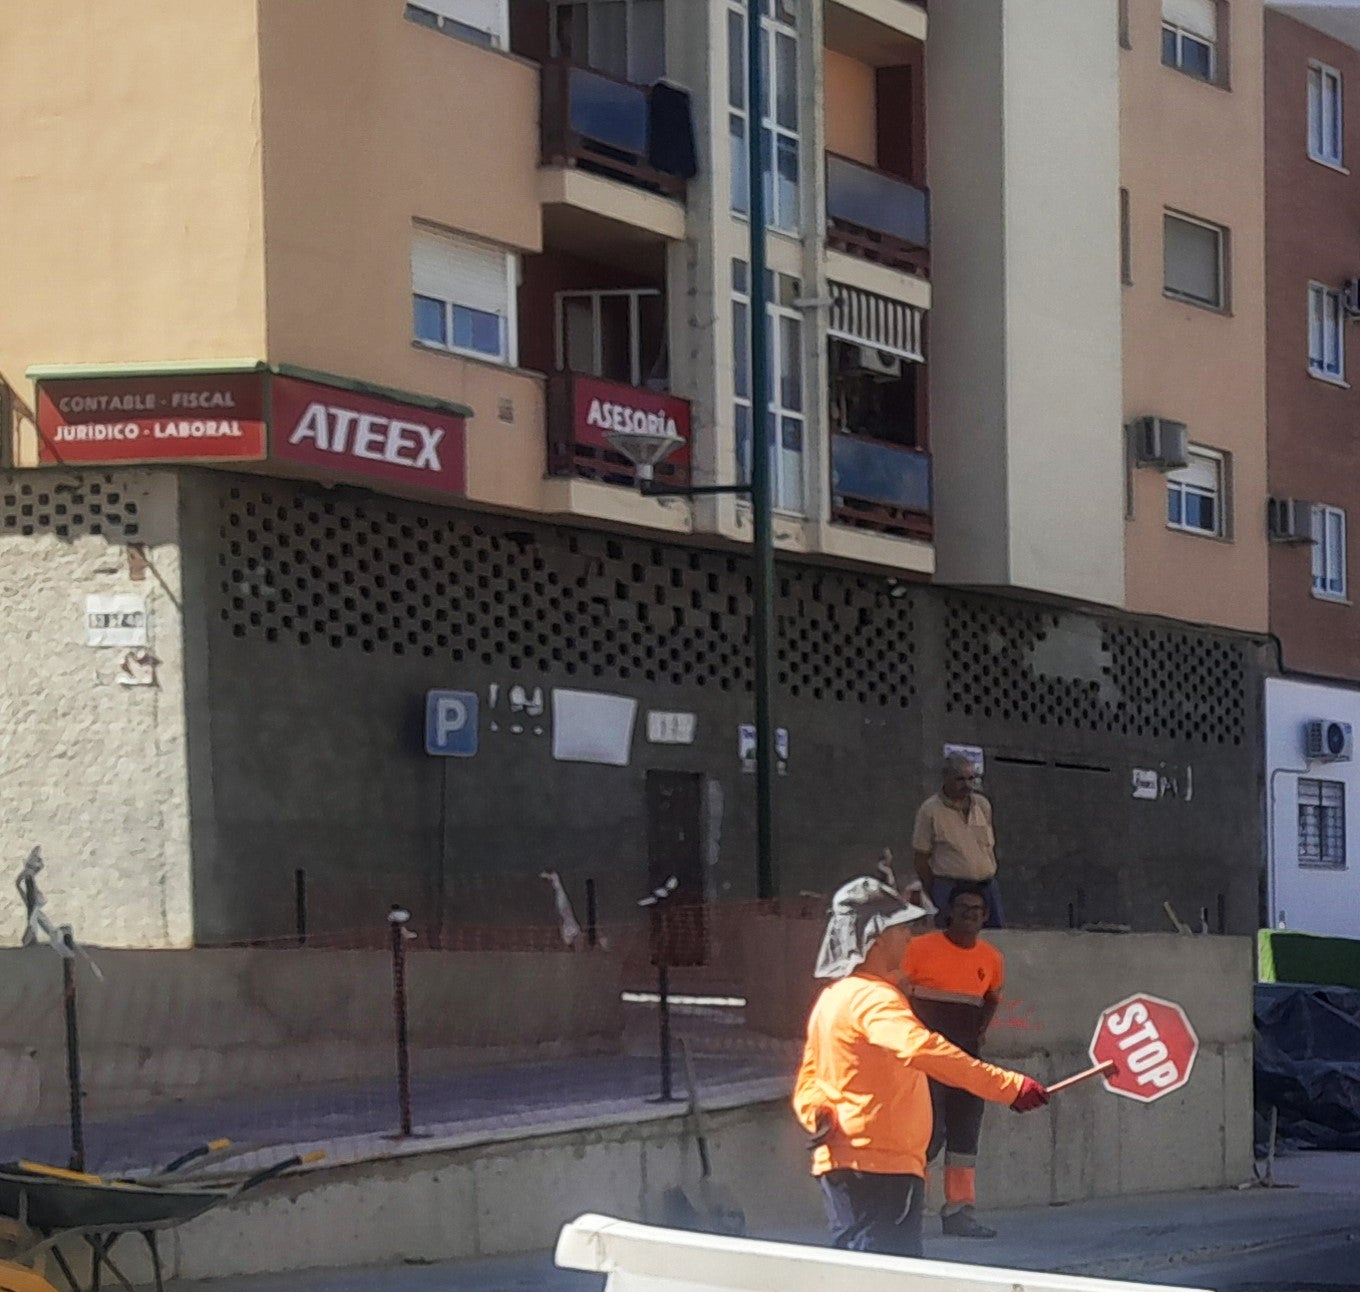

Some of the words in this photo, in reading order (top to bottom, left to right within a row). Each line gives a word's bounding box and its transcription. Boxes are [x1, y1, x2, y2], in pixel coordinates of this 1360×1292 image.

[59, 394, 155, 412] CONTABLE
[171, 391, 235, 408] FISCAL
[154, 420, 242, 438] LABORAL
[288, 402, 446, 471] ATEEX
[437, 698, 467, 747] P
[1107, 1003, 1179, 1087] STOP
